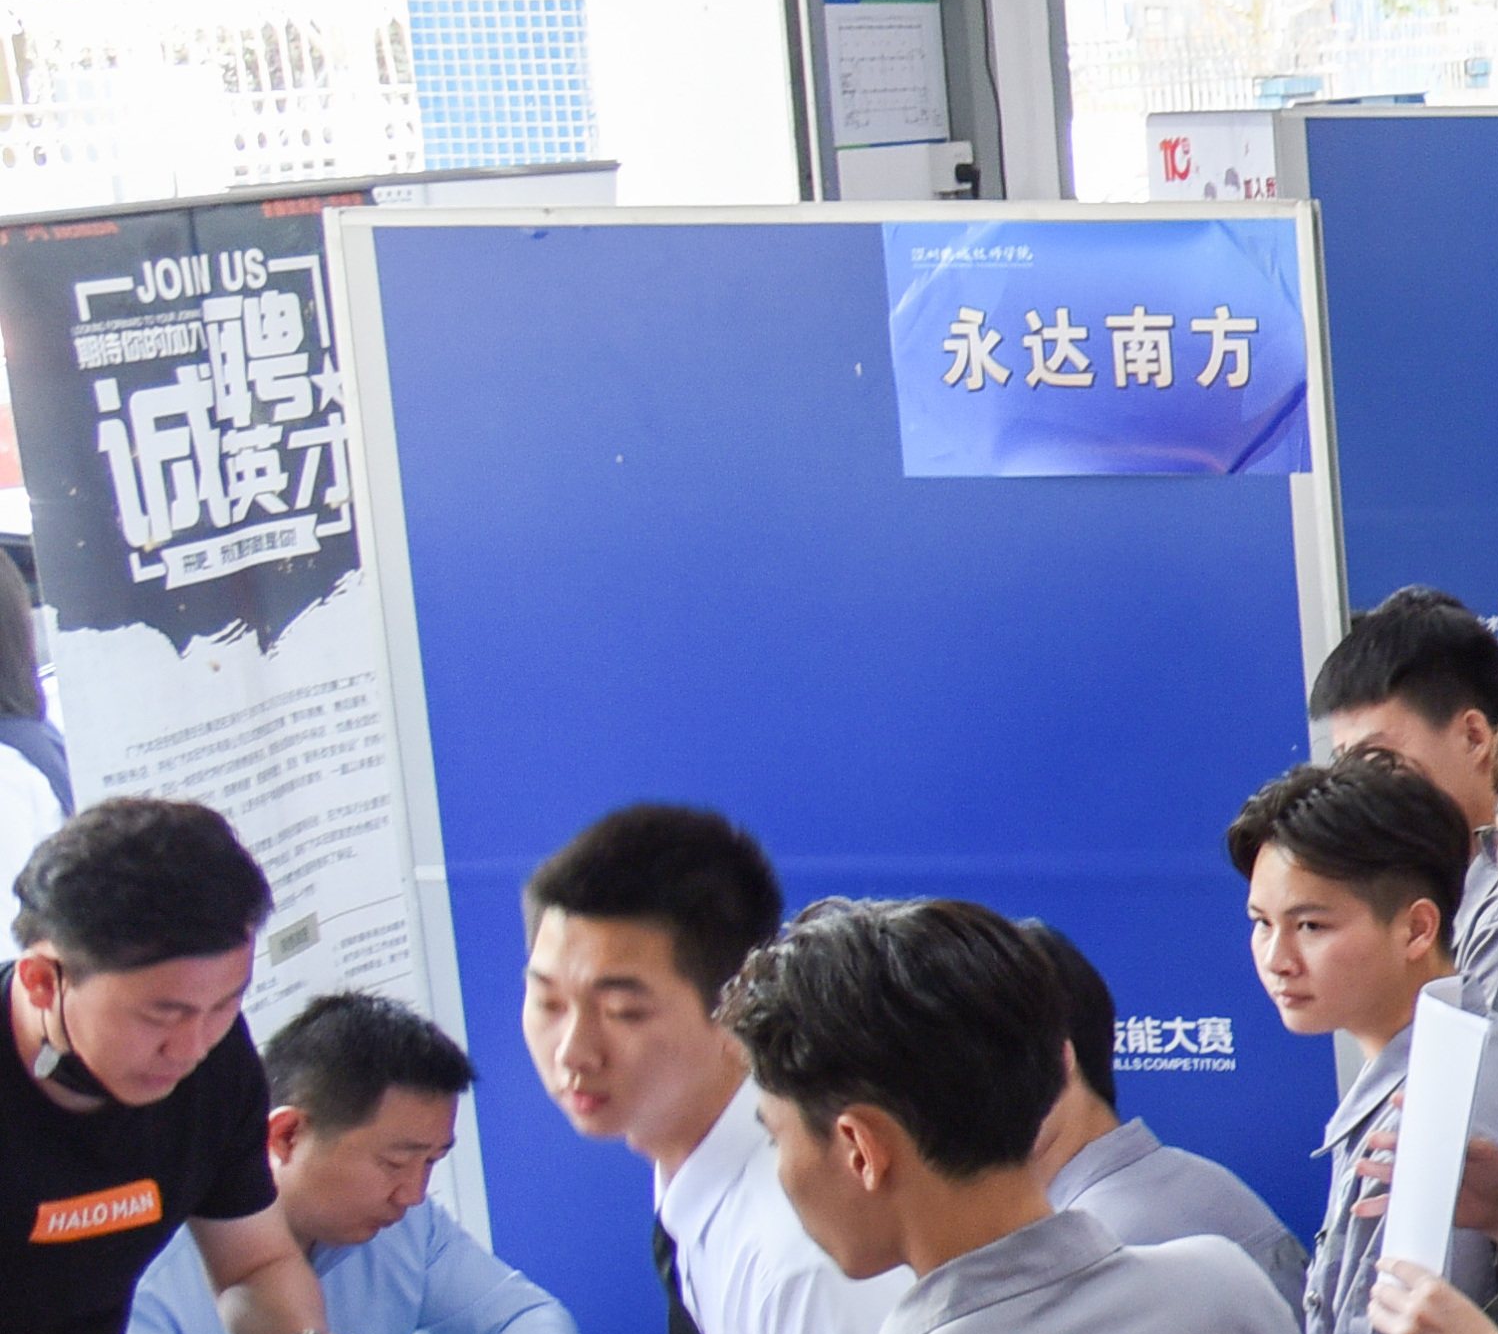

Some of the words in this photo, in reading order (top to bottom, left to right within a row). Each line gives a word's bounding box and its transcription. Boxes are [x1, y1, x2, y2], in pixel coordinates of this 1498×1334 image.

[136, 253, 212, 305] JOIN
[219, 246, 268, 292] US
[942, 306, 1257, 391] 永达南方
[47, 1206, 109, 1234] HALO
[110, 1188, 154, 1223] MAN
